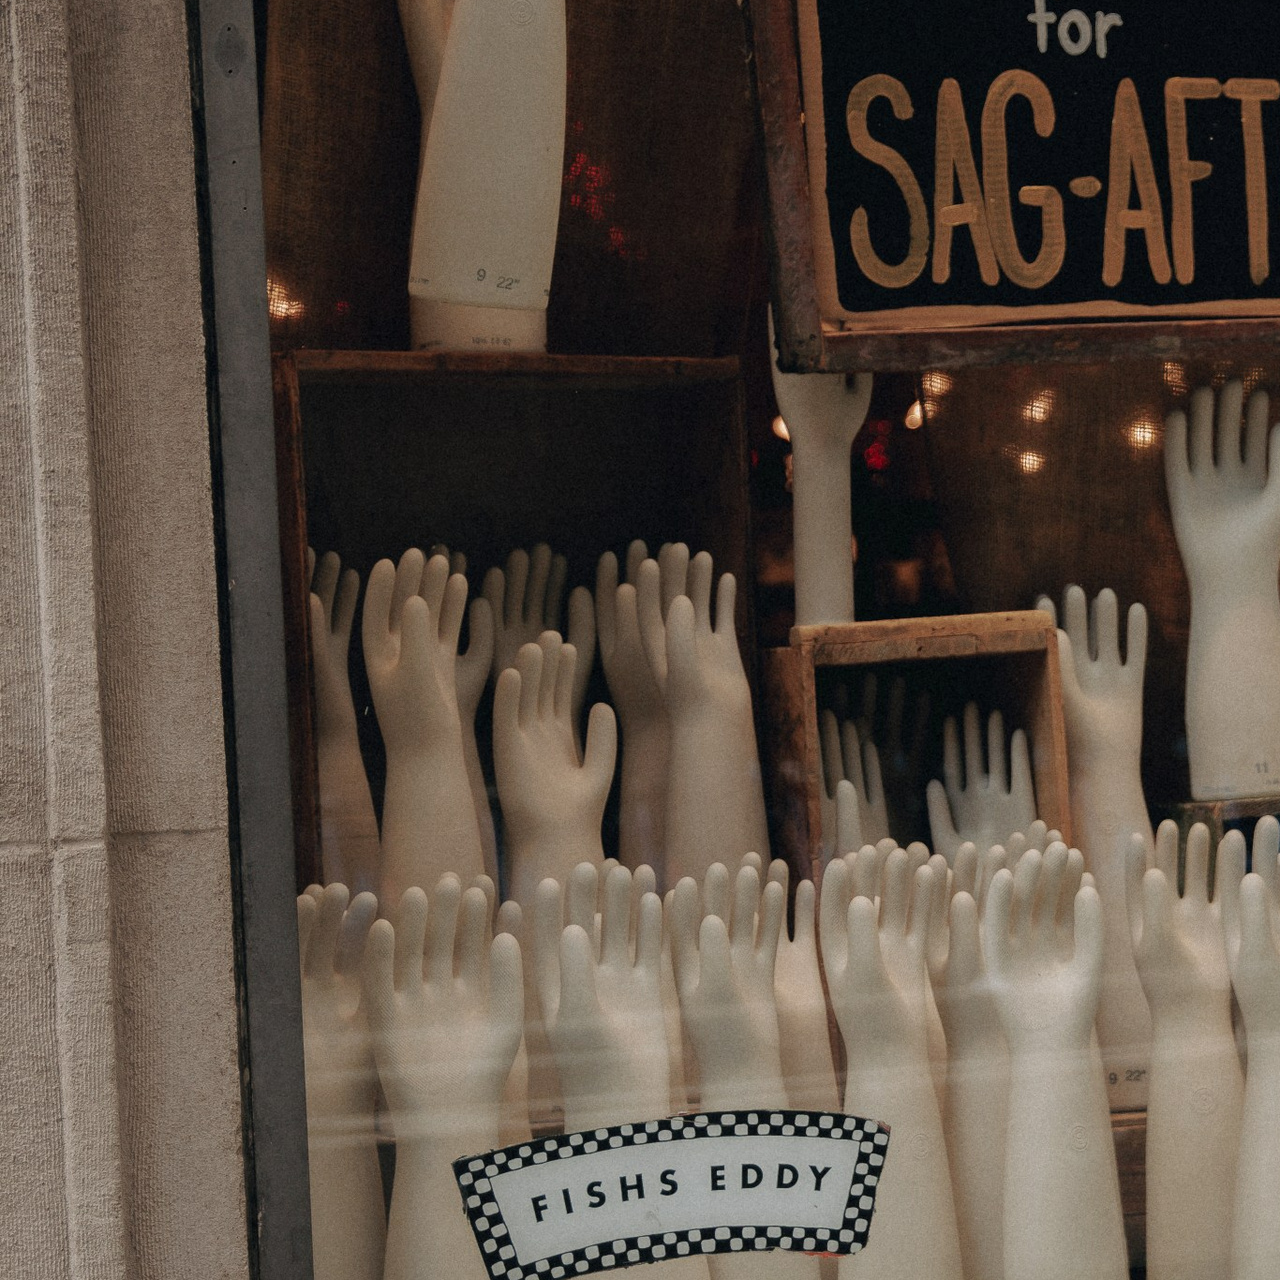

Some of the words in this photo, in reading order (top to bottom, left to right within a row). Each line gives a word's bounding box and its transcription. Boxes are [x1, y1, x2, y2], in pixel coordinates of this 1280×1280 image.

[476, 268, 487, 282] 9
[531, 1168, 679, 1223] FISHS
[710, 1163, 832, 1192] EDDY
